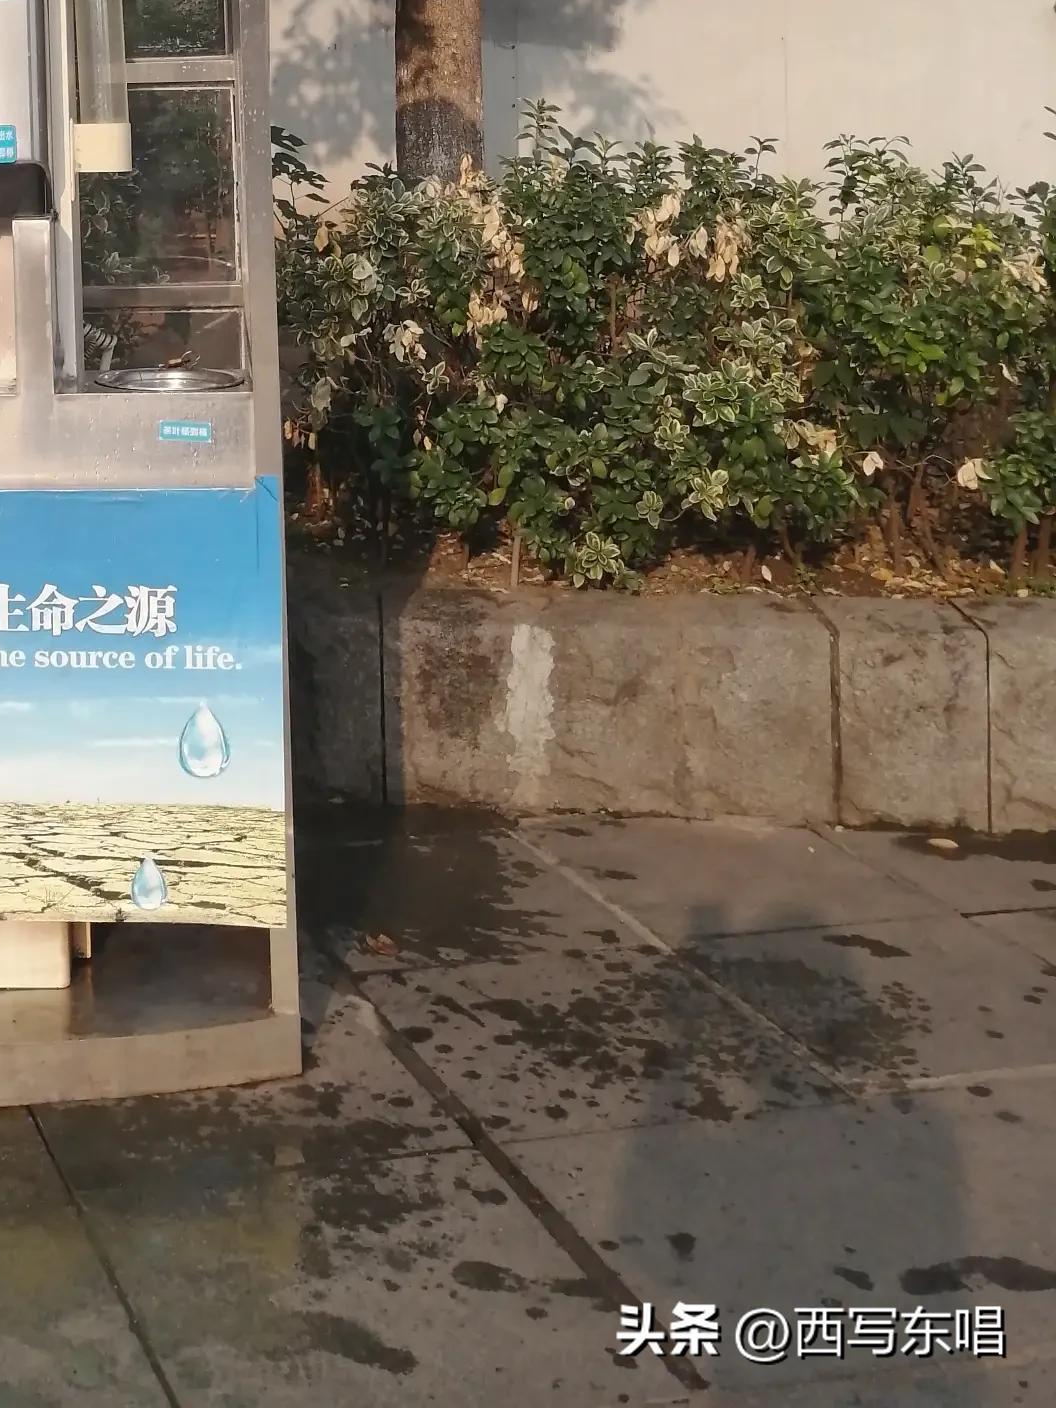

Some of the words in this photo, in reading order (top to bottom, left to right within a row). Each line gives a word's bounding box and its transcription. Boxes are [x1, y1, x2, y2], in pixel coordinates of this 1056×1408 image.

[34, 649, 134, 670] source
[144, 644, 178, 670] of
[183, 645, 243, 672] life.
